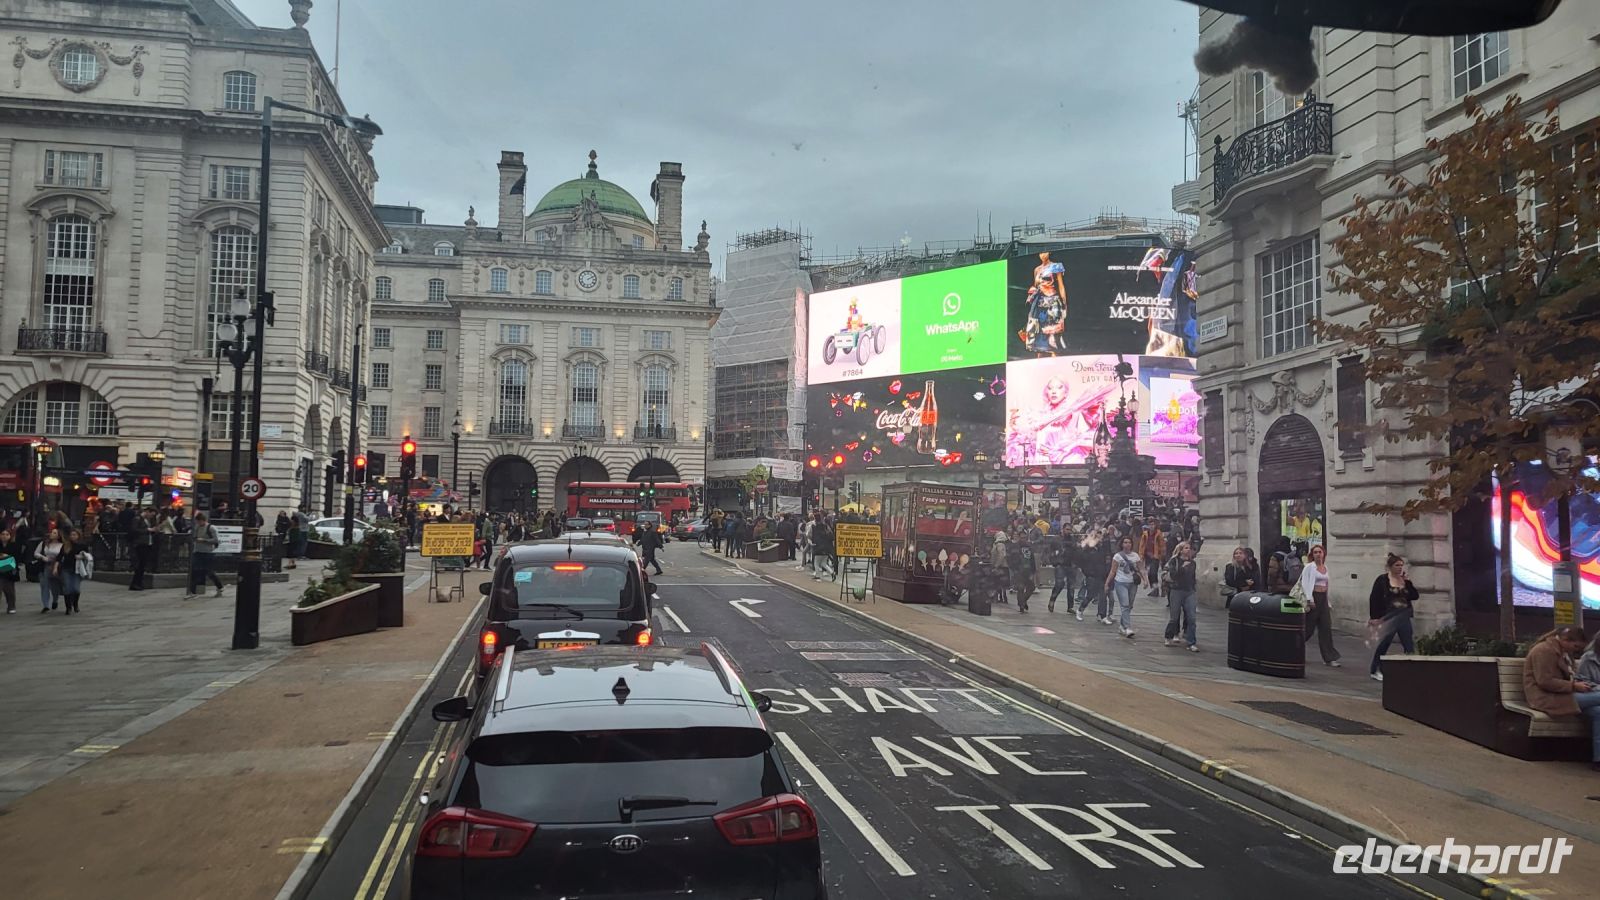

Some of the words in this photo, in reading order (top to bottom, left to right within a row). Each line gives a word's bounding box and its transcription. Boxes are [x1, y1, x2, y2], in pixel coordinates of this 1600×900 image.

[1113, 292, 1172, 306] Alexander
[1108, 306, 1177, 322] McQUEEN
[925, 319, 980, 335] WhatsApp
[842, 368, 864, 377] #7864
[1071, 360, 1095, 373] Dom
[1082, 375, 1102, 384] LADY
[244, 484, 259, 493] 20
[757, 687, 1003, 715] SHAFT
[871, 736, 1087, 776] AVE
[615, 838, 638, 850] KIA
